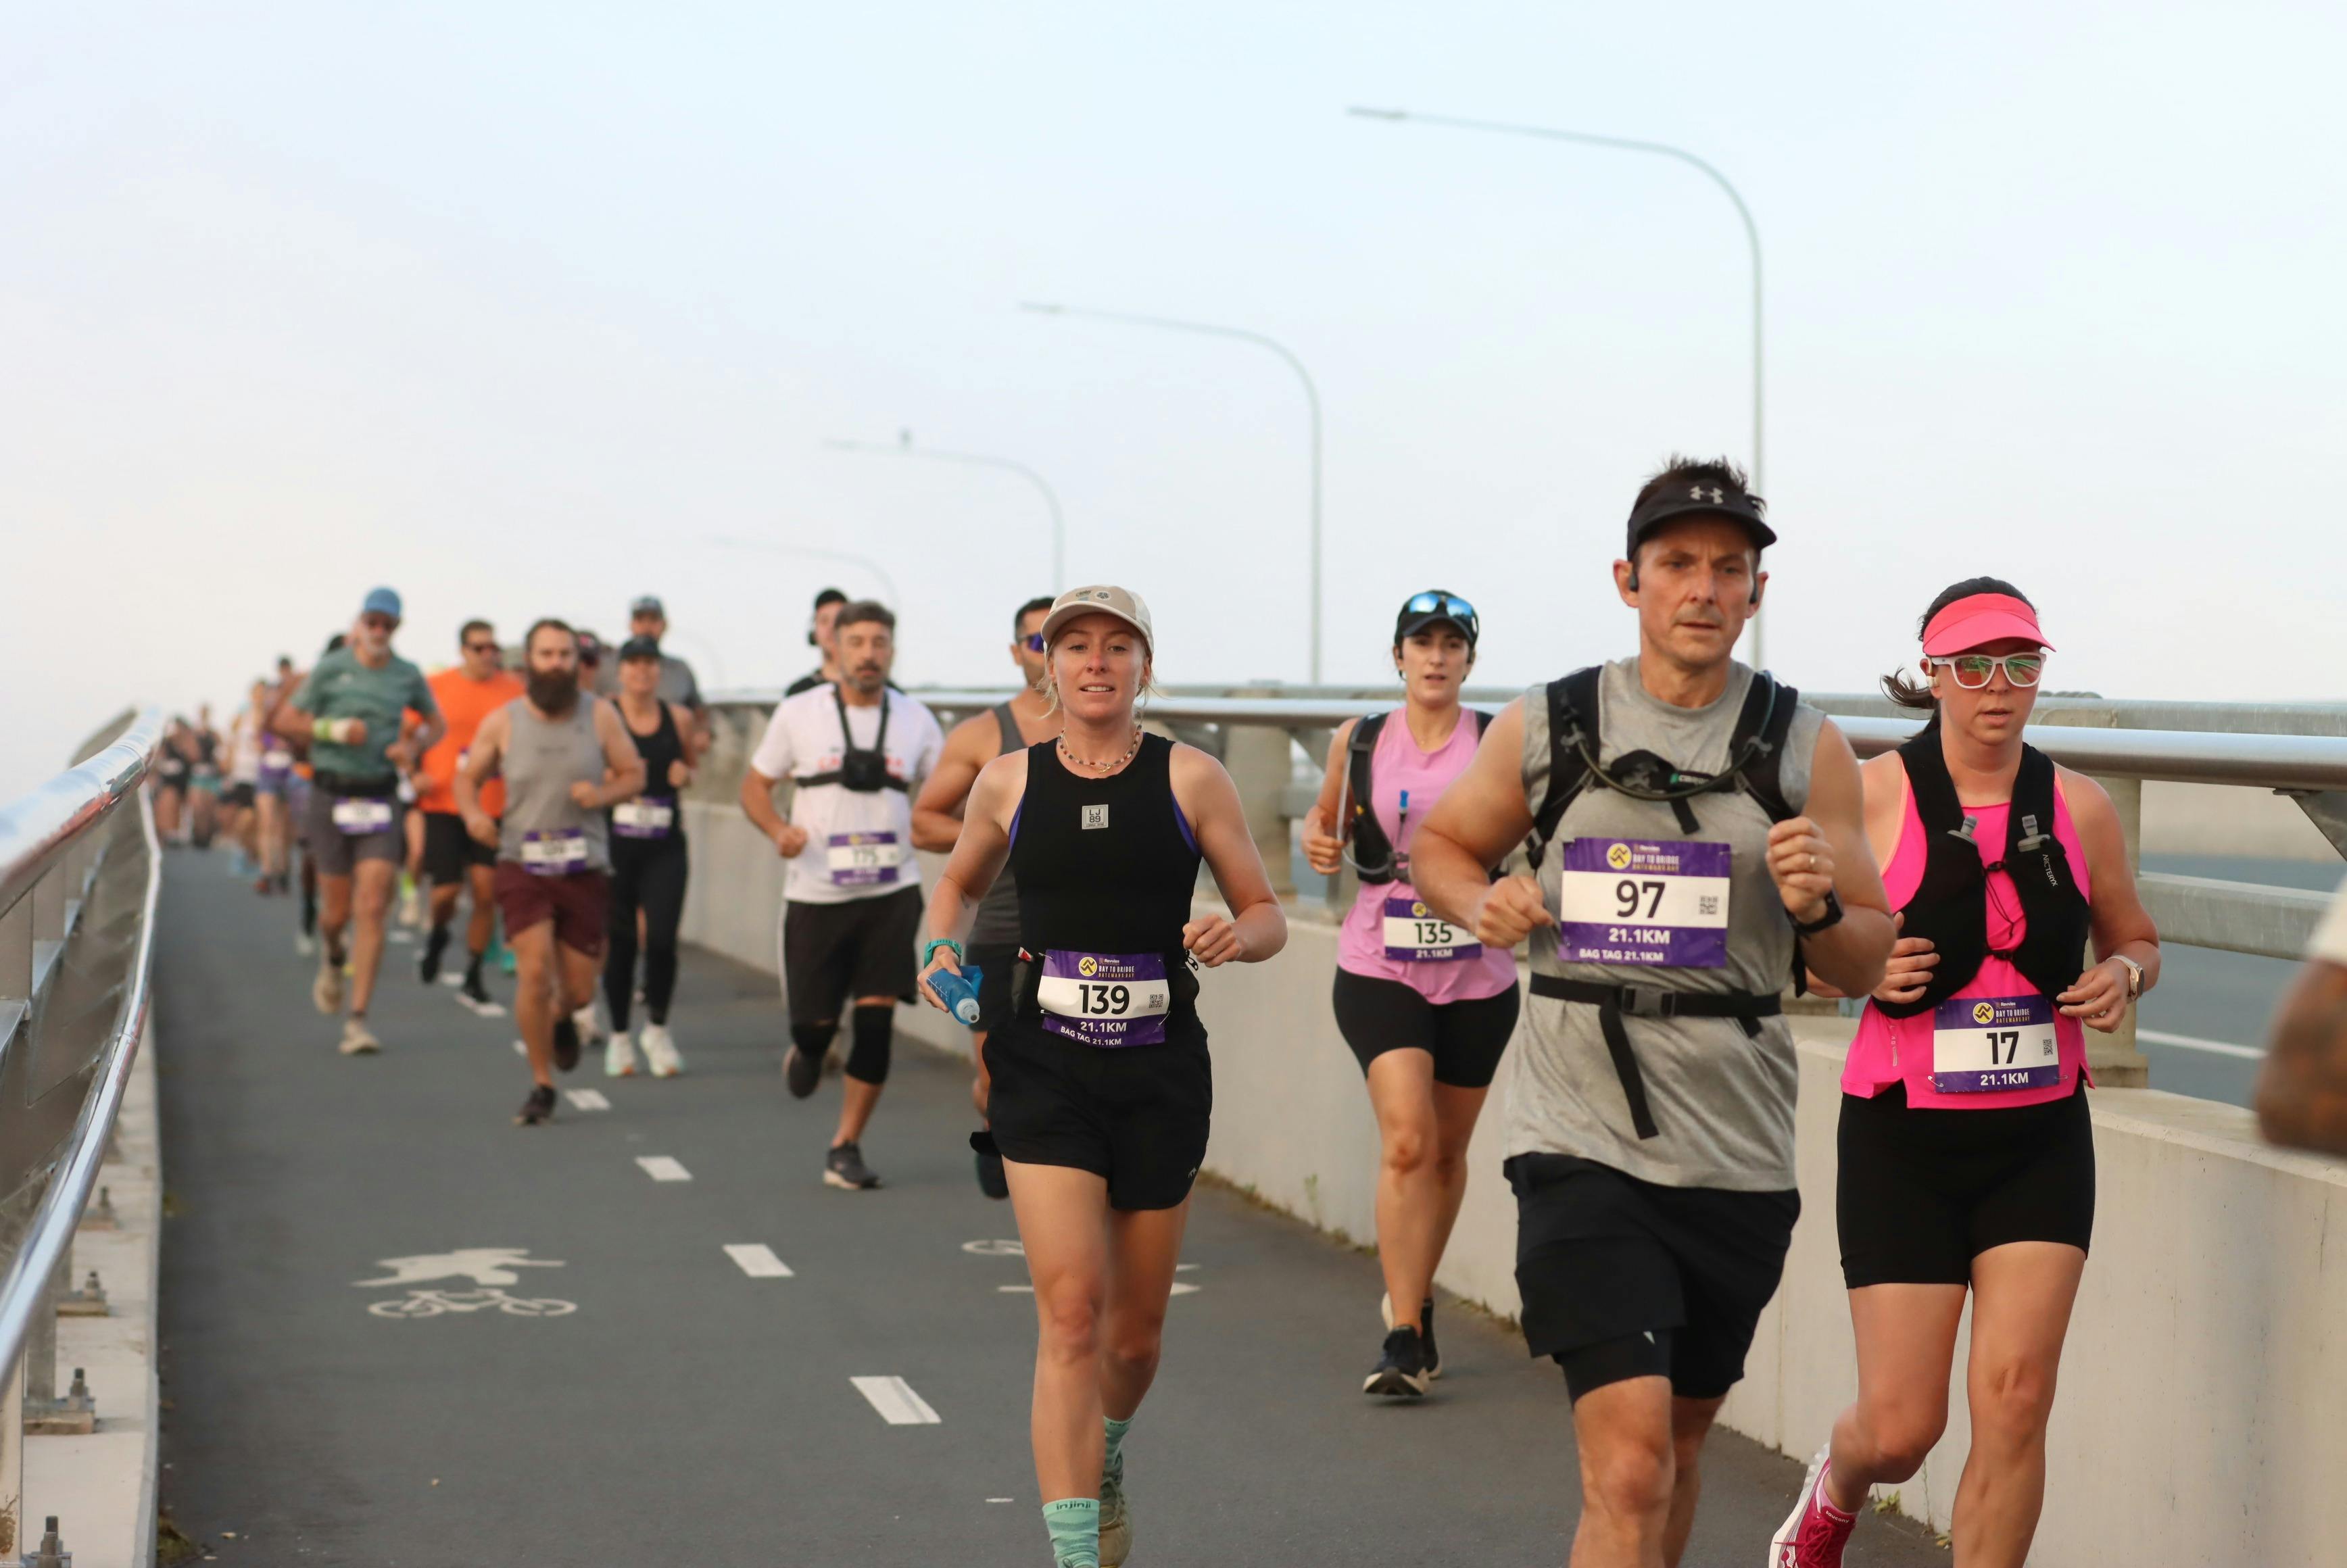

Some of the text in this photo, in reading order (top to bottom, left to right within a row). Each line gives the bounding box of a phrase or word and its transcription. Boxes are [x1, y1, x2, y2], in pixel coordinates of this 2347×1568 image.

[1616, 879, 1666, 918] 97
[1415, 923, 1453, 944] 135
[1608, 927, 1670, 945] 21.1KM
[1416, 948, 1453, 958] 21.1KM
[1579, 948, 1664, 962] BAG TAG 21.1KM
[1079, 984, 1130, 1014] 139
[2014, 1008, 2029, 1016] BRIDGE
[1080, 1021, 1128, 1033] 21.1KM
[1061, 1025, 1122, 1046] BAG TAG 21.1KM
[1987, 1031, 2019, 1065] 17
[1980, 1072, 2029, 1086] 21.1KM
[1057, 1501, 1091, 1511] injinji
[1826, 1510, 1849, 1523] saucony
